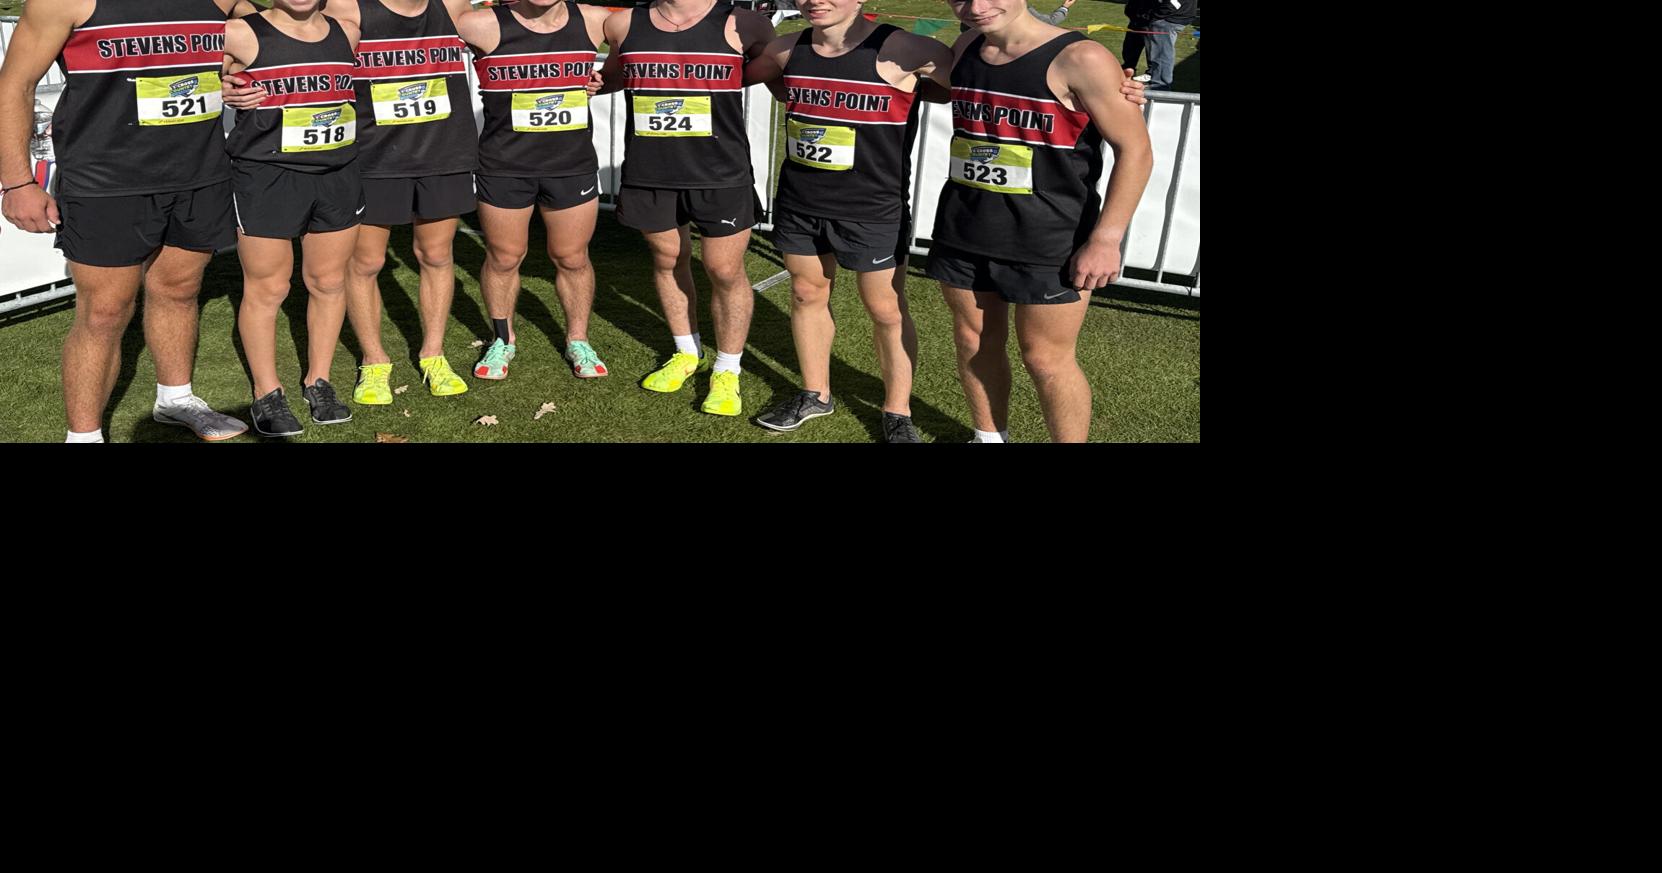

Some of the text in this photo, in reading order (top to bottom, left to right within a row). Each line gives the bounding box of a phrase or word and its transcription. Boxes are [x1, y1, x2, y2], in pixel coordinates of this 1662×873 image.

[97, 33, 225, 59] STEVENS POIN
[353, 46, 460, 68] STEVENS POIN
[487, 63, 561, 81] STEVENS
[683, 63, 734, 80] POINT
[162, 98, 207, 118] 521
[393, 100, 436, 118] 519
[787, 87, 892, 112] EVENS POINT
[529, 110, 572, 126] 520
[649, 116, 692, 131] 524
[952, 100, 1055, 133] EVENS POINT
[303, 126, 345, 145] 518
[796, 142, 832, 163] 522
[963, 162, 1008, 185] 523
